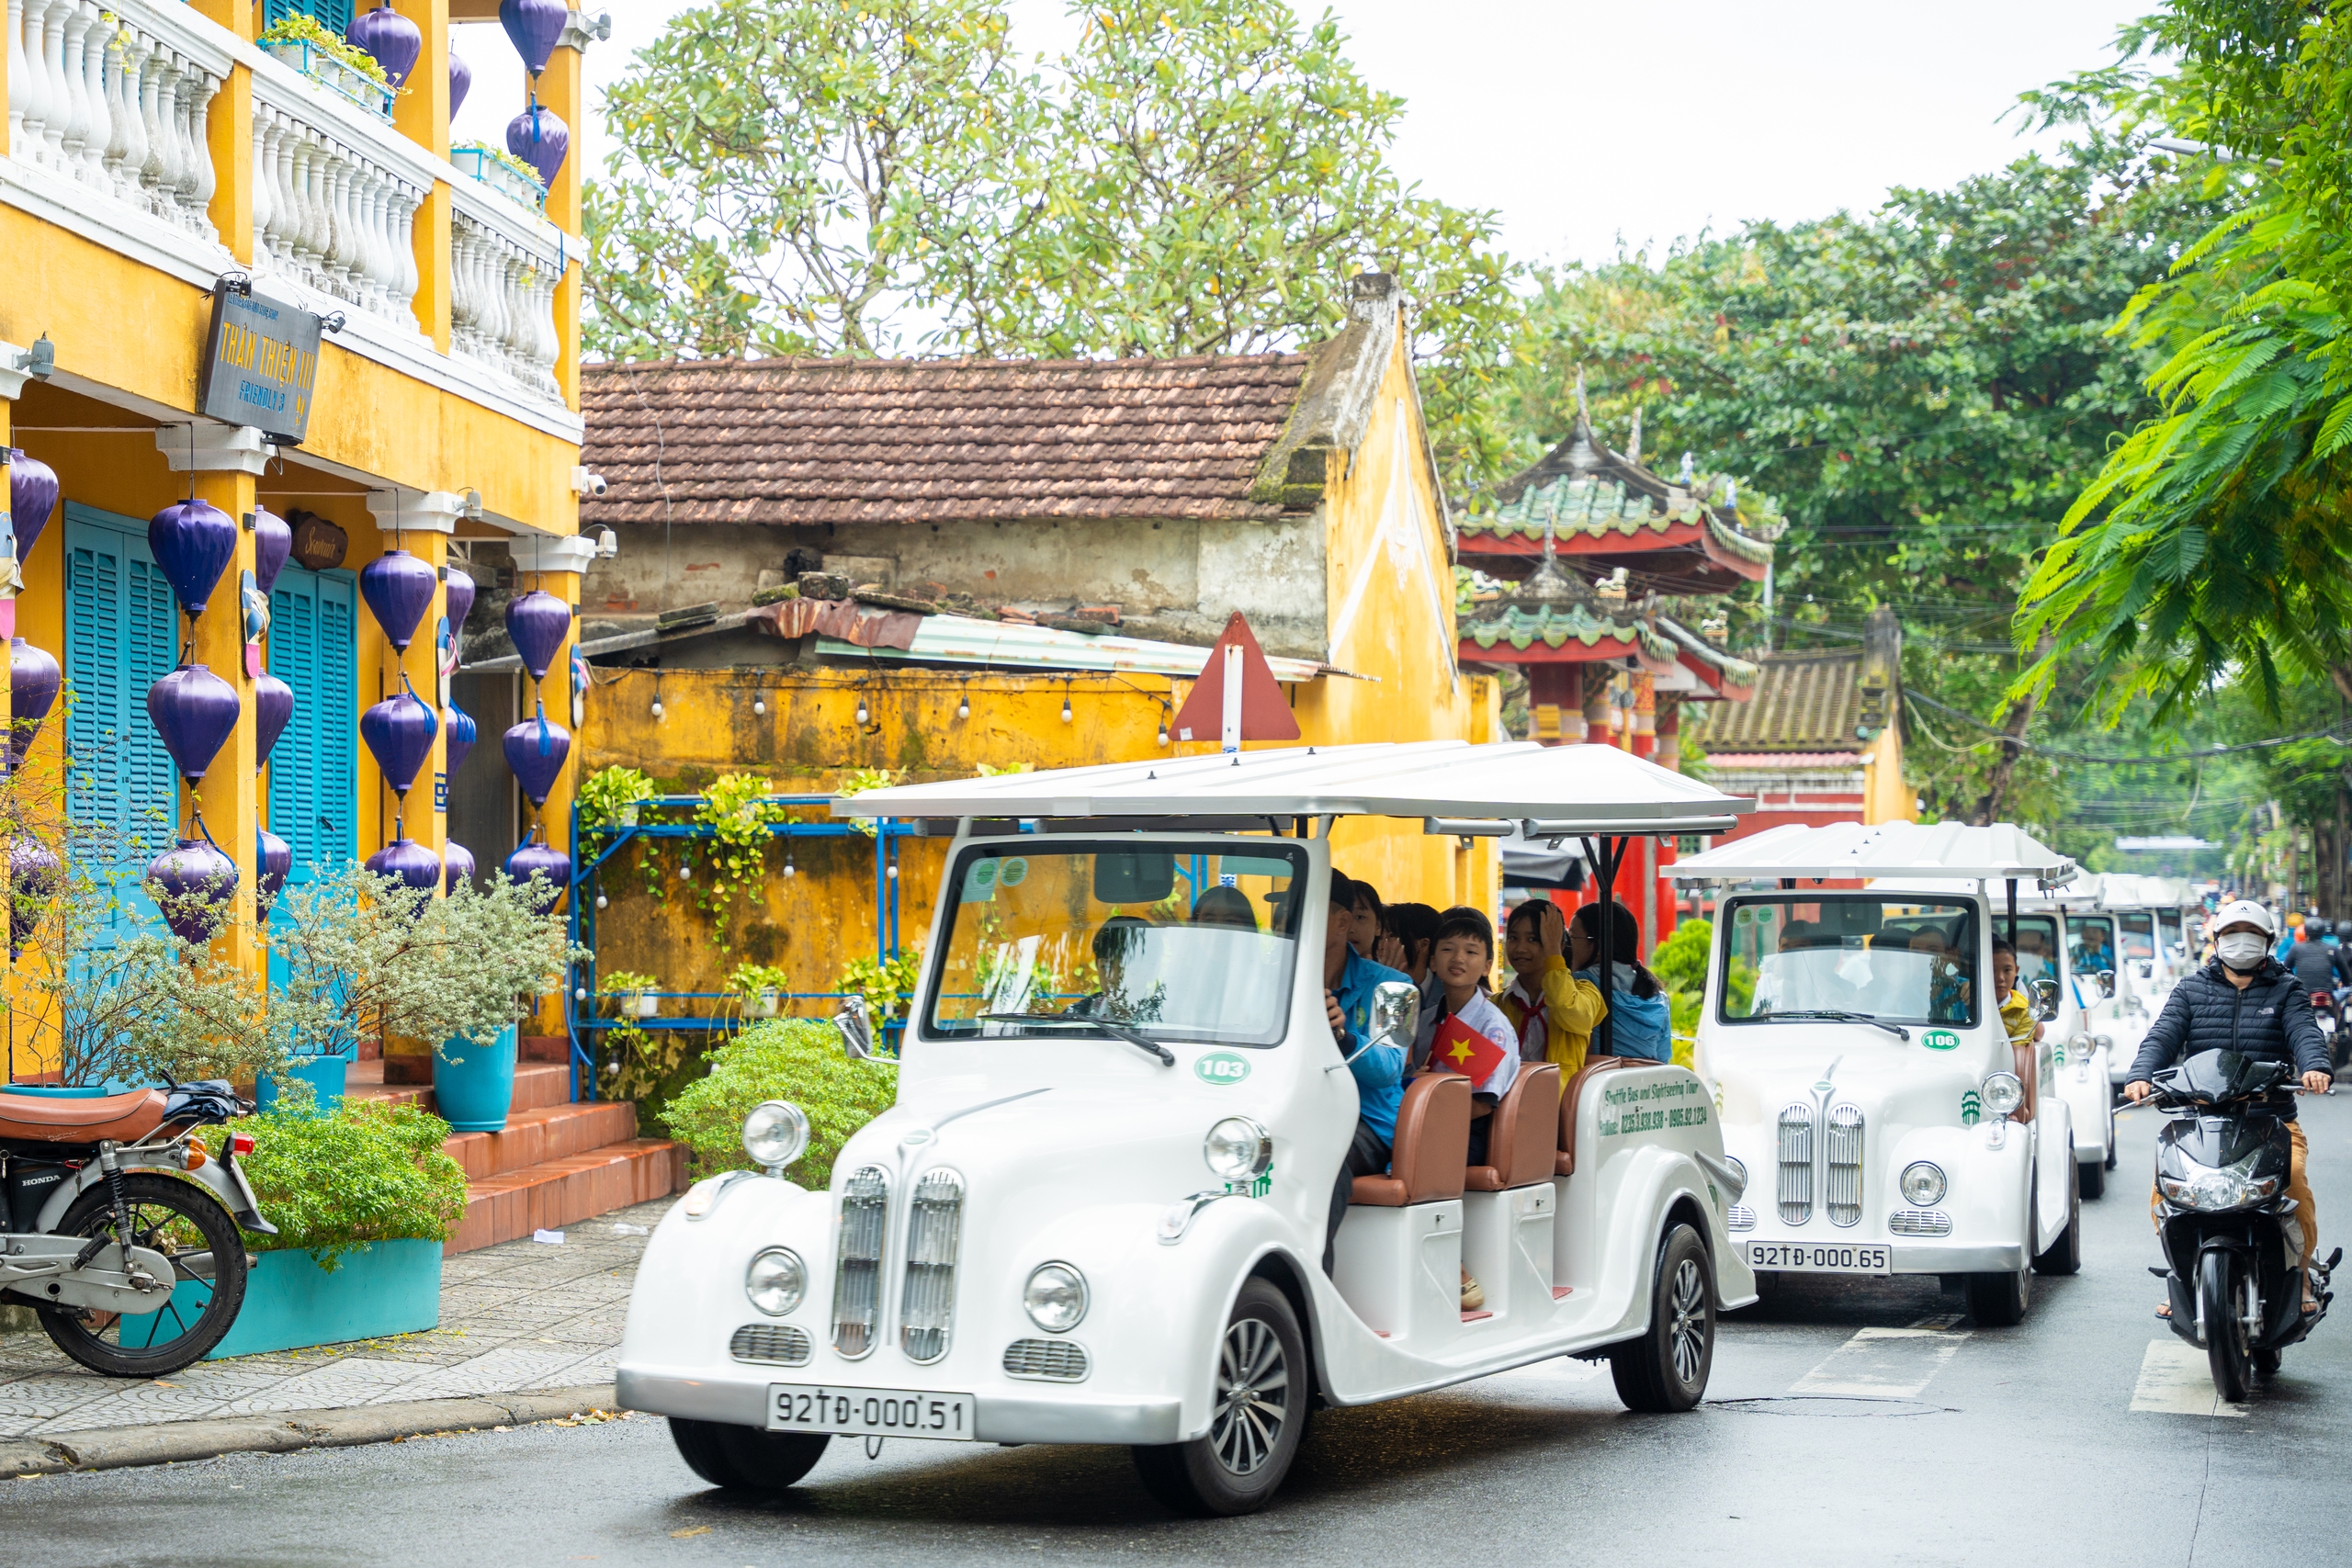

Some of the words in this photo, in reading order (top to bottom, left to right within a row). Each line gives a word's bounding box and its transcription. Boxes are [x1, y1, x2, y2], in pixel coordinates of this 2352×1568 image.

[220, 321, 257, 370] THÂN
[259, 334, 298, 388] THIỆN
[298, 351, 315, 390] III
[238, 380, 277, 412] FRIENDLY
[277, 393, 285, 413] 3
[1926, 1034, 1955, 1046] 106
[1202, 1059, 1245, 1077] 103
[1605, 1088, 1626, 1106] Shuttle
[1627, 1087, 1639, 1102] Bus
[1640, 1084, 1651, 1100] and
[1651, 1081, 1684, 1103] Sightseeing
[1685, 1079, 1699, 1095] Tour
[22, 1174, 62, 1187] HONDA
[1753, 1247, 1884, 1269] 92TĐ-000.65
[776, 1393, 962, 1431] 92TĐ-000.51
